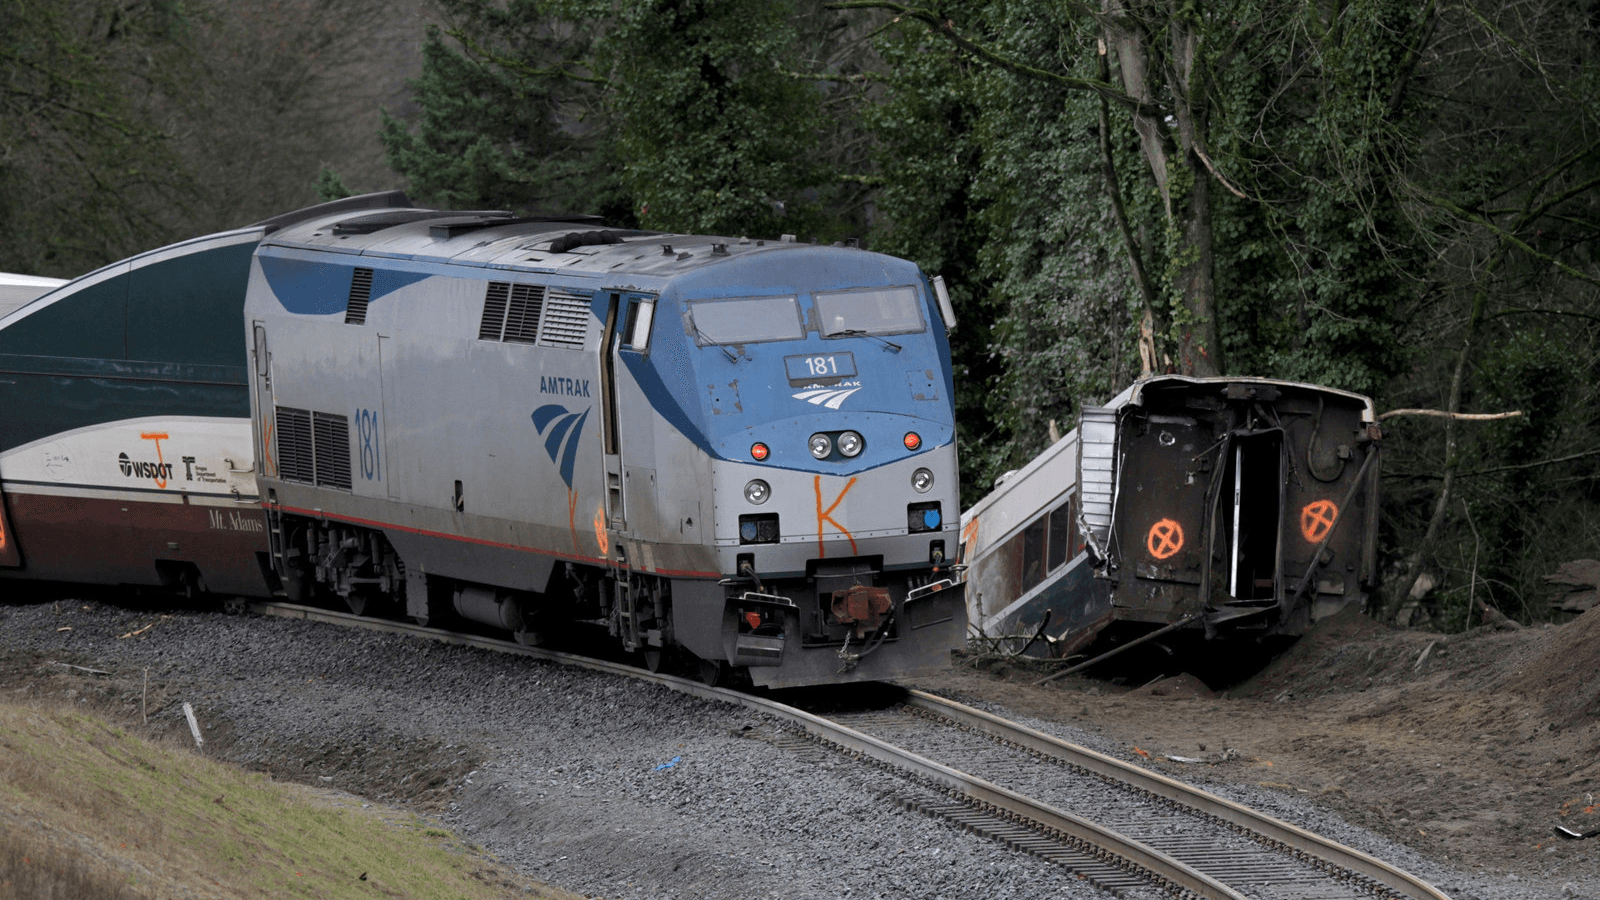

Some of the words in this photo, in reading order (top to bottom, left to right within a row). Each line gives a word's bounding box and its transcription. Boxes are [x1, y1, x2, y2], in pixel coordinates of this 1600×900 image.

[805, 356, 837, 375] 181
[540, 375, 590, 398] AMTRAK
[355, 407, 381, 482] 181
[131, 461, 173, 480] WSDOT
[209, 509, 227, 530] Mt.
[229, 510, 264, 533] Adams
[814, 474, 859, 560] K
